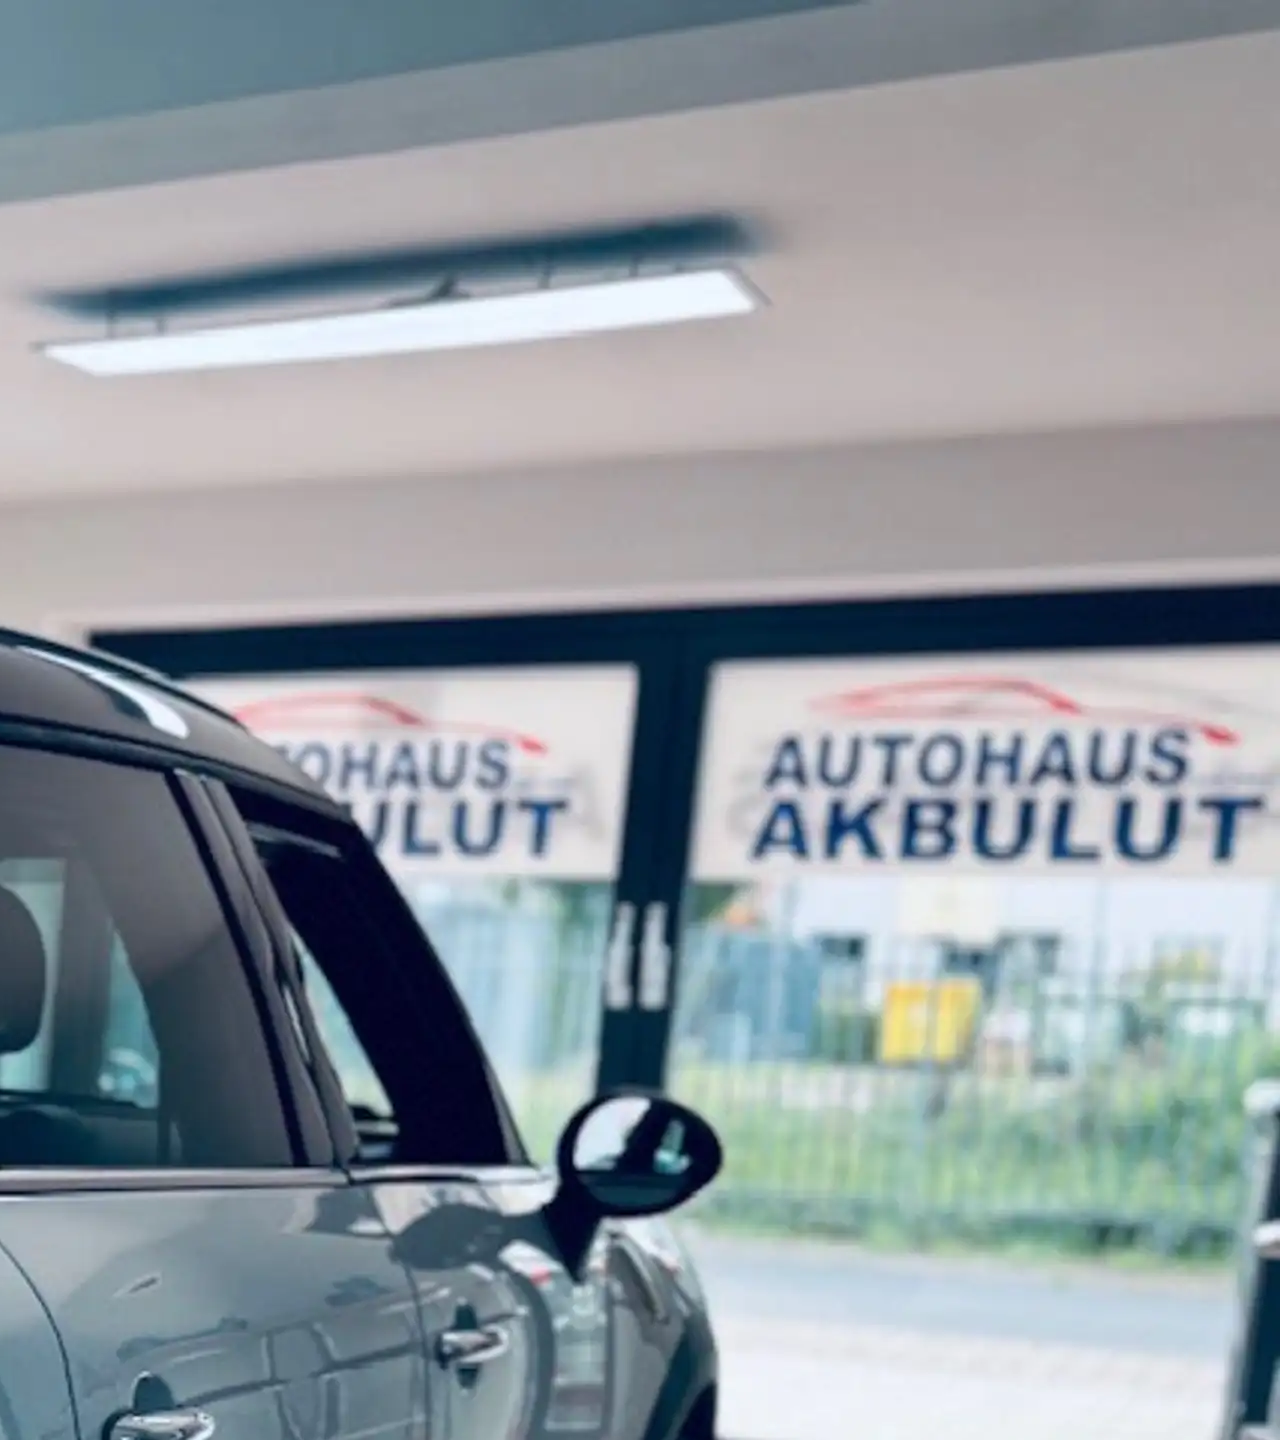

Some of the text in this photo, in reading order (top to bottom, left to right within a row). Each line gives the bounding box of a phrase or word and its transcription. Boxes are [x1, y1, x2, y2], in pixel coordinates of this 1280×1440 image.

[272, 738, 510, 793] OHAUS
[764, 728, 1192, 791] AUTOHAUS
[748, 796, 1265, 863] AKBULUT
